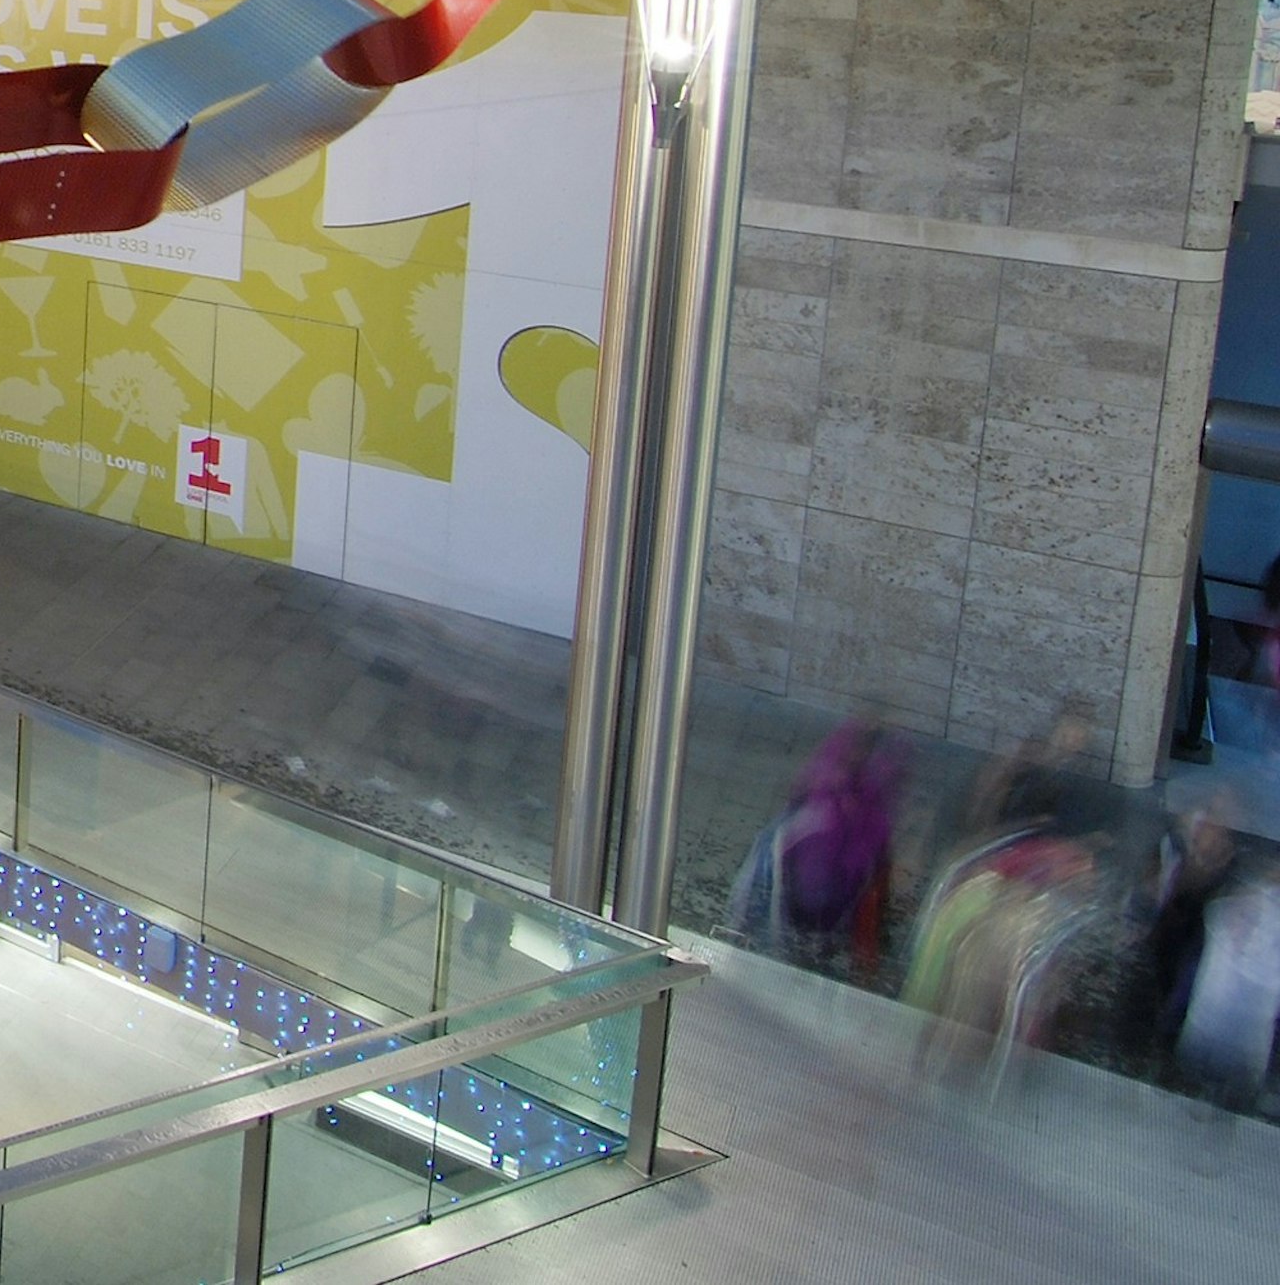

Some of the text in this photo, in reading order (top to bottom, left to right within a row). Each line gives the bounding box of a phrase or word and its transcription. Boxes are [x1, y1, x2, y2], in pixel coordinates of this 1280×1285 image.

[117, 237, 149, 254] 833
[155, 243, 197, 262] 1197
[73, 442, 103, 464] YOU
[106, 453, 148, 476] LOVE
[150, 463, 167, 480] IN
